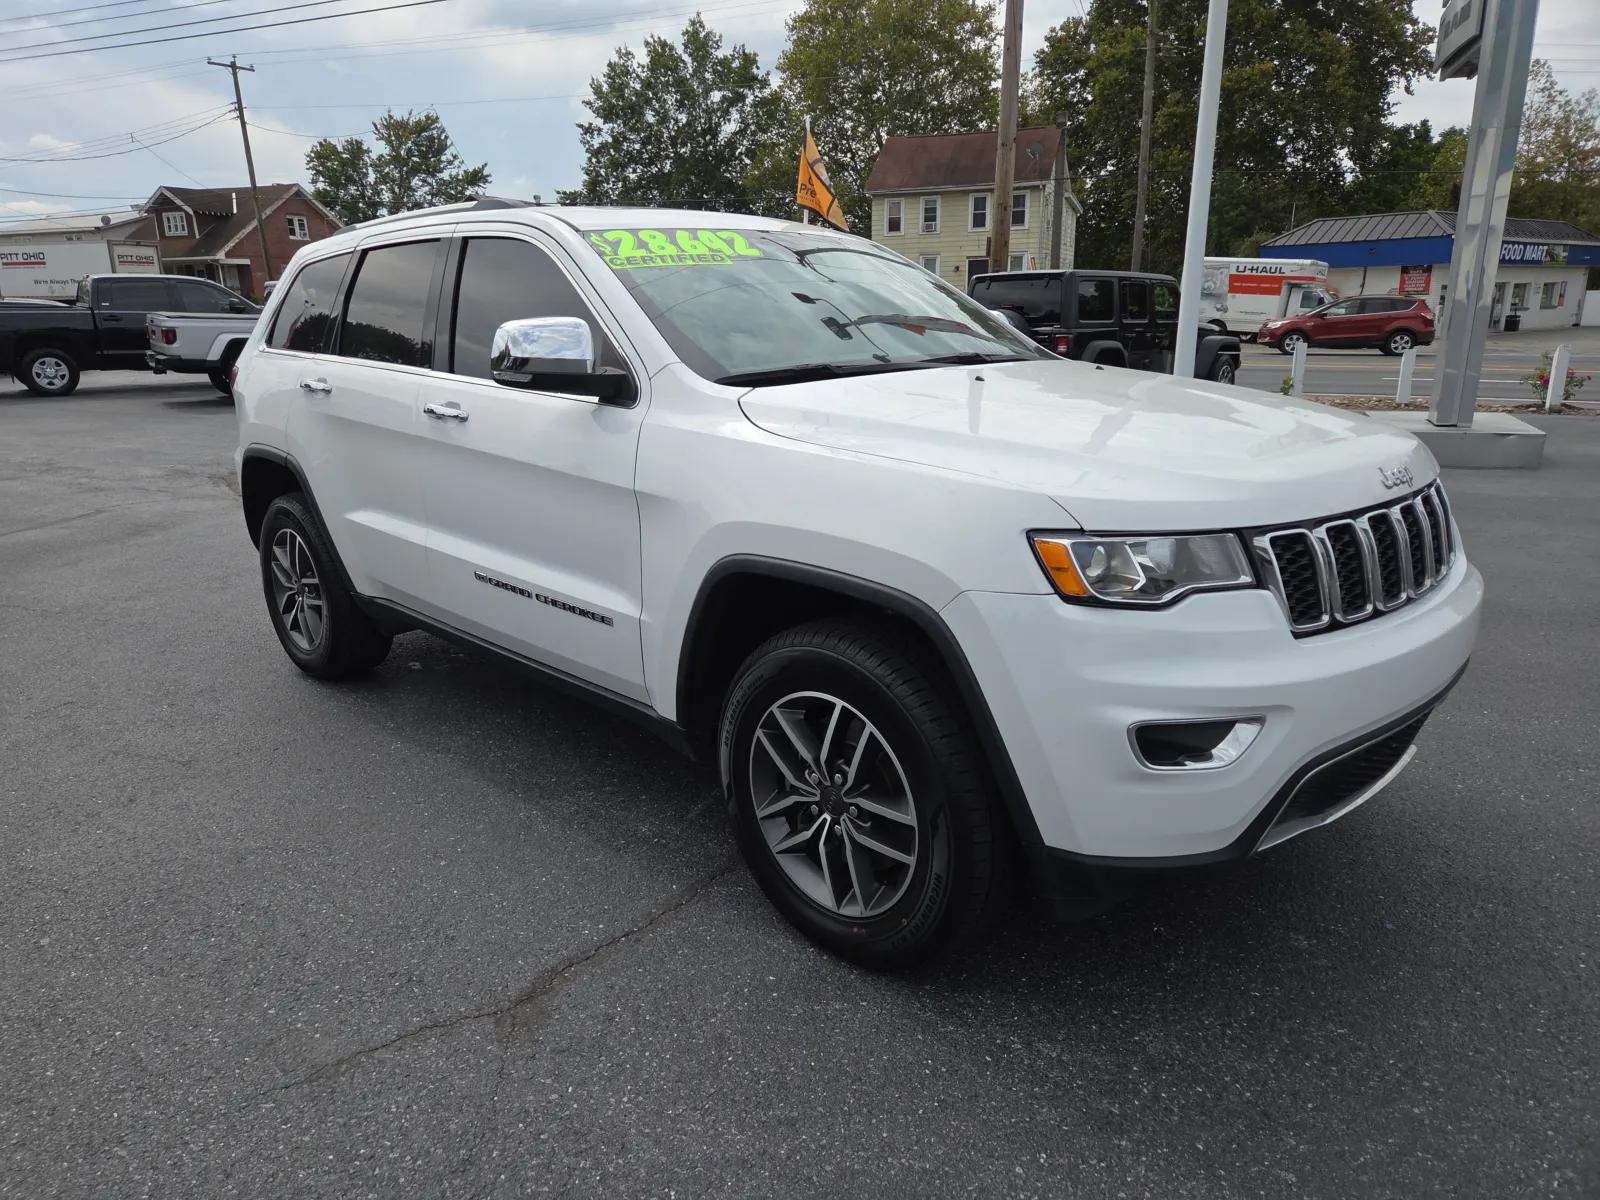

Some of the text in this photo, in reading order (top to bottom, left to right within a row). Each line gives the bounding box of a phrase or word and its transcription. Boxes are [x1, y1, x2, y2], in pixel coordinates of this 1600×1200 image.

[0, 252, 46, 261] PITT OHIO
[1500, 244, 1548, 260] FOOD MART
[608, 253, 727, 267] CERTIFIED
[1236, 265, 1285, 274] U-HAUL
[1379, 466, 1413, 489] Jeep
[488, 577, 614, 627] GRAND CHEROKEE
